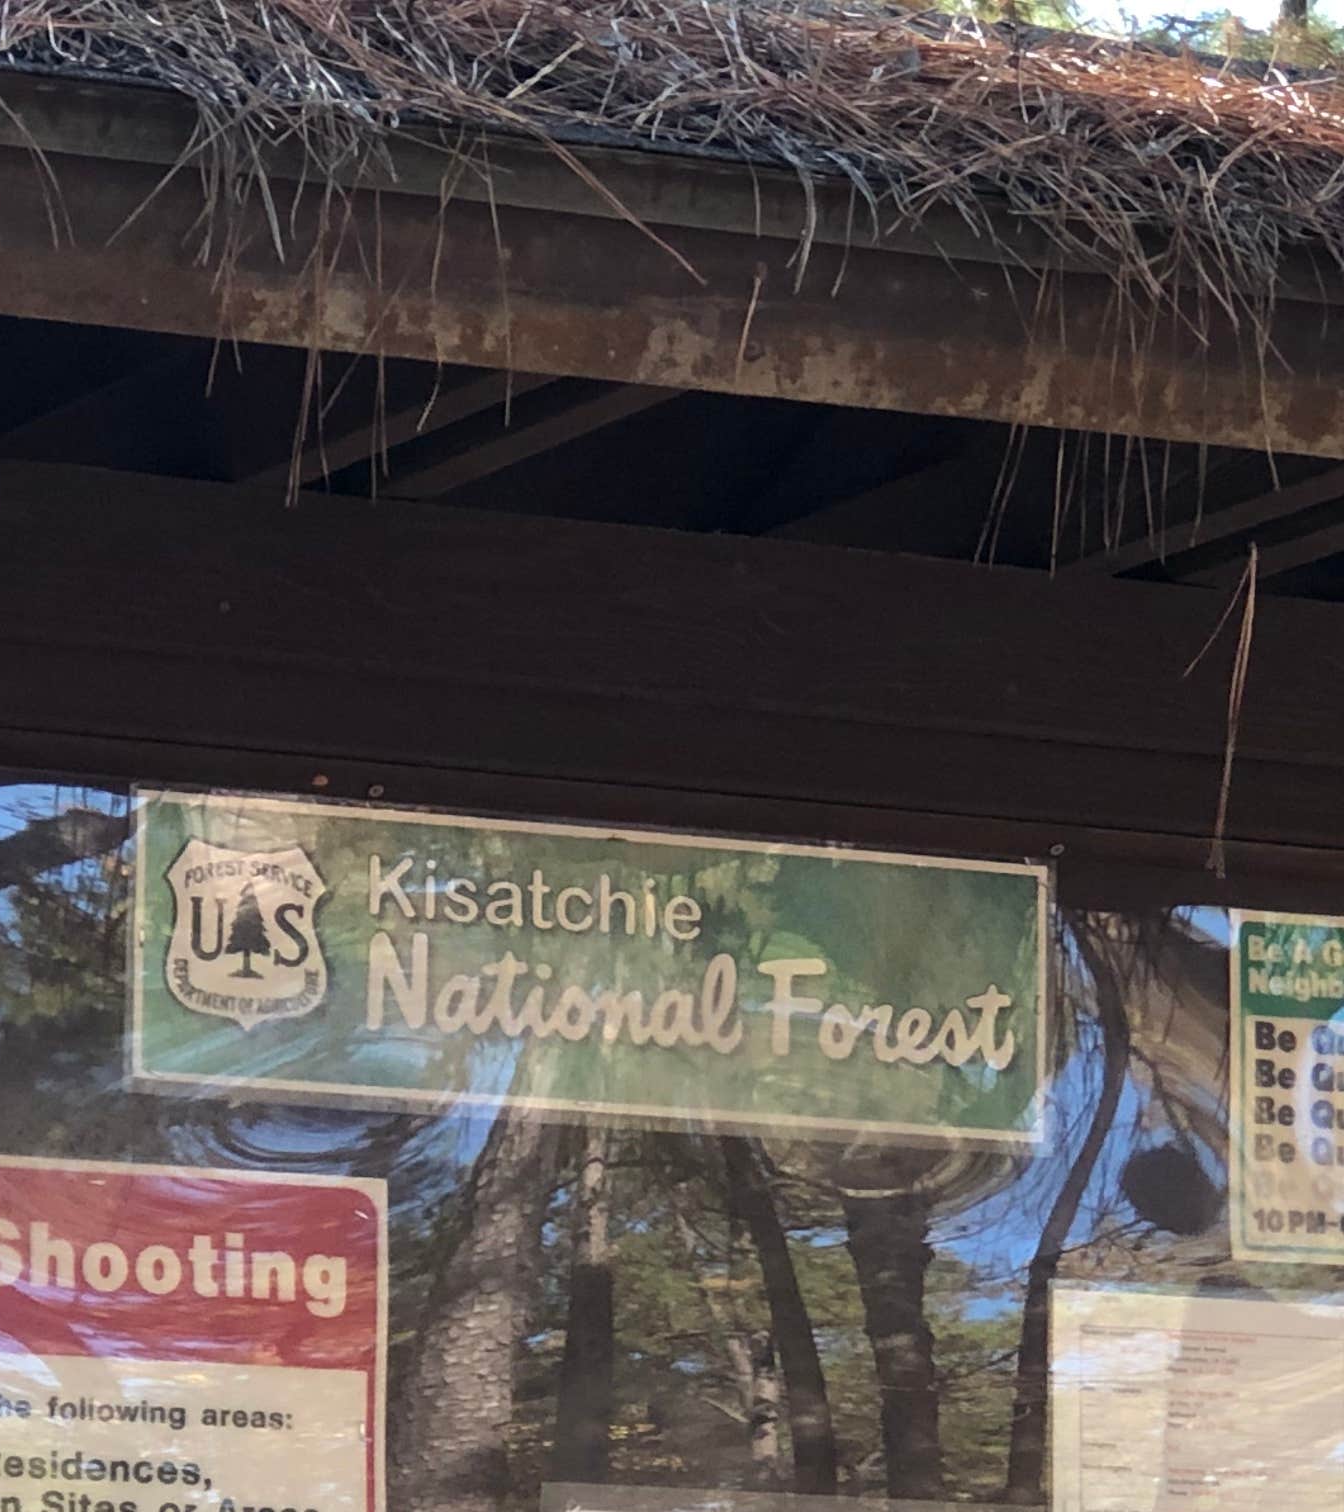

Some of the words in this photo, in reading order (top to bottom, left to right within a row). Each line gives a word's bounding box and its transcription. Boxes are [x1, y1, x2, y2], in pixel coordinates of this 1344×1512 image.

[184, 860, 245, 889] FOREST
[248, 861, 313, 897] SERVICE
[367, 852, 703, 941] Kisatchie
[1248, 934, 1283, 961] Be
[1293, 938, 1313, 964] A
[363, 931, 743, 1055] National
[757, 957, 1016, 1072] Forest
[1255, 1021, 1297, 1053] Be
[1255, 1058, 1296, 1090] Be
[1254, 1096, 1296, 1126] Be
[1254, 1133, 1296, 1164] Be
[1253, 1208, 1285, 1233] 10
[48, 1396, 187, 1430] following
[201, 1407, 294, 1431] areas:
